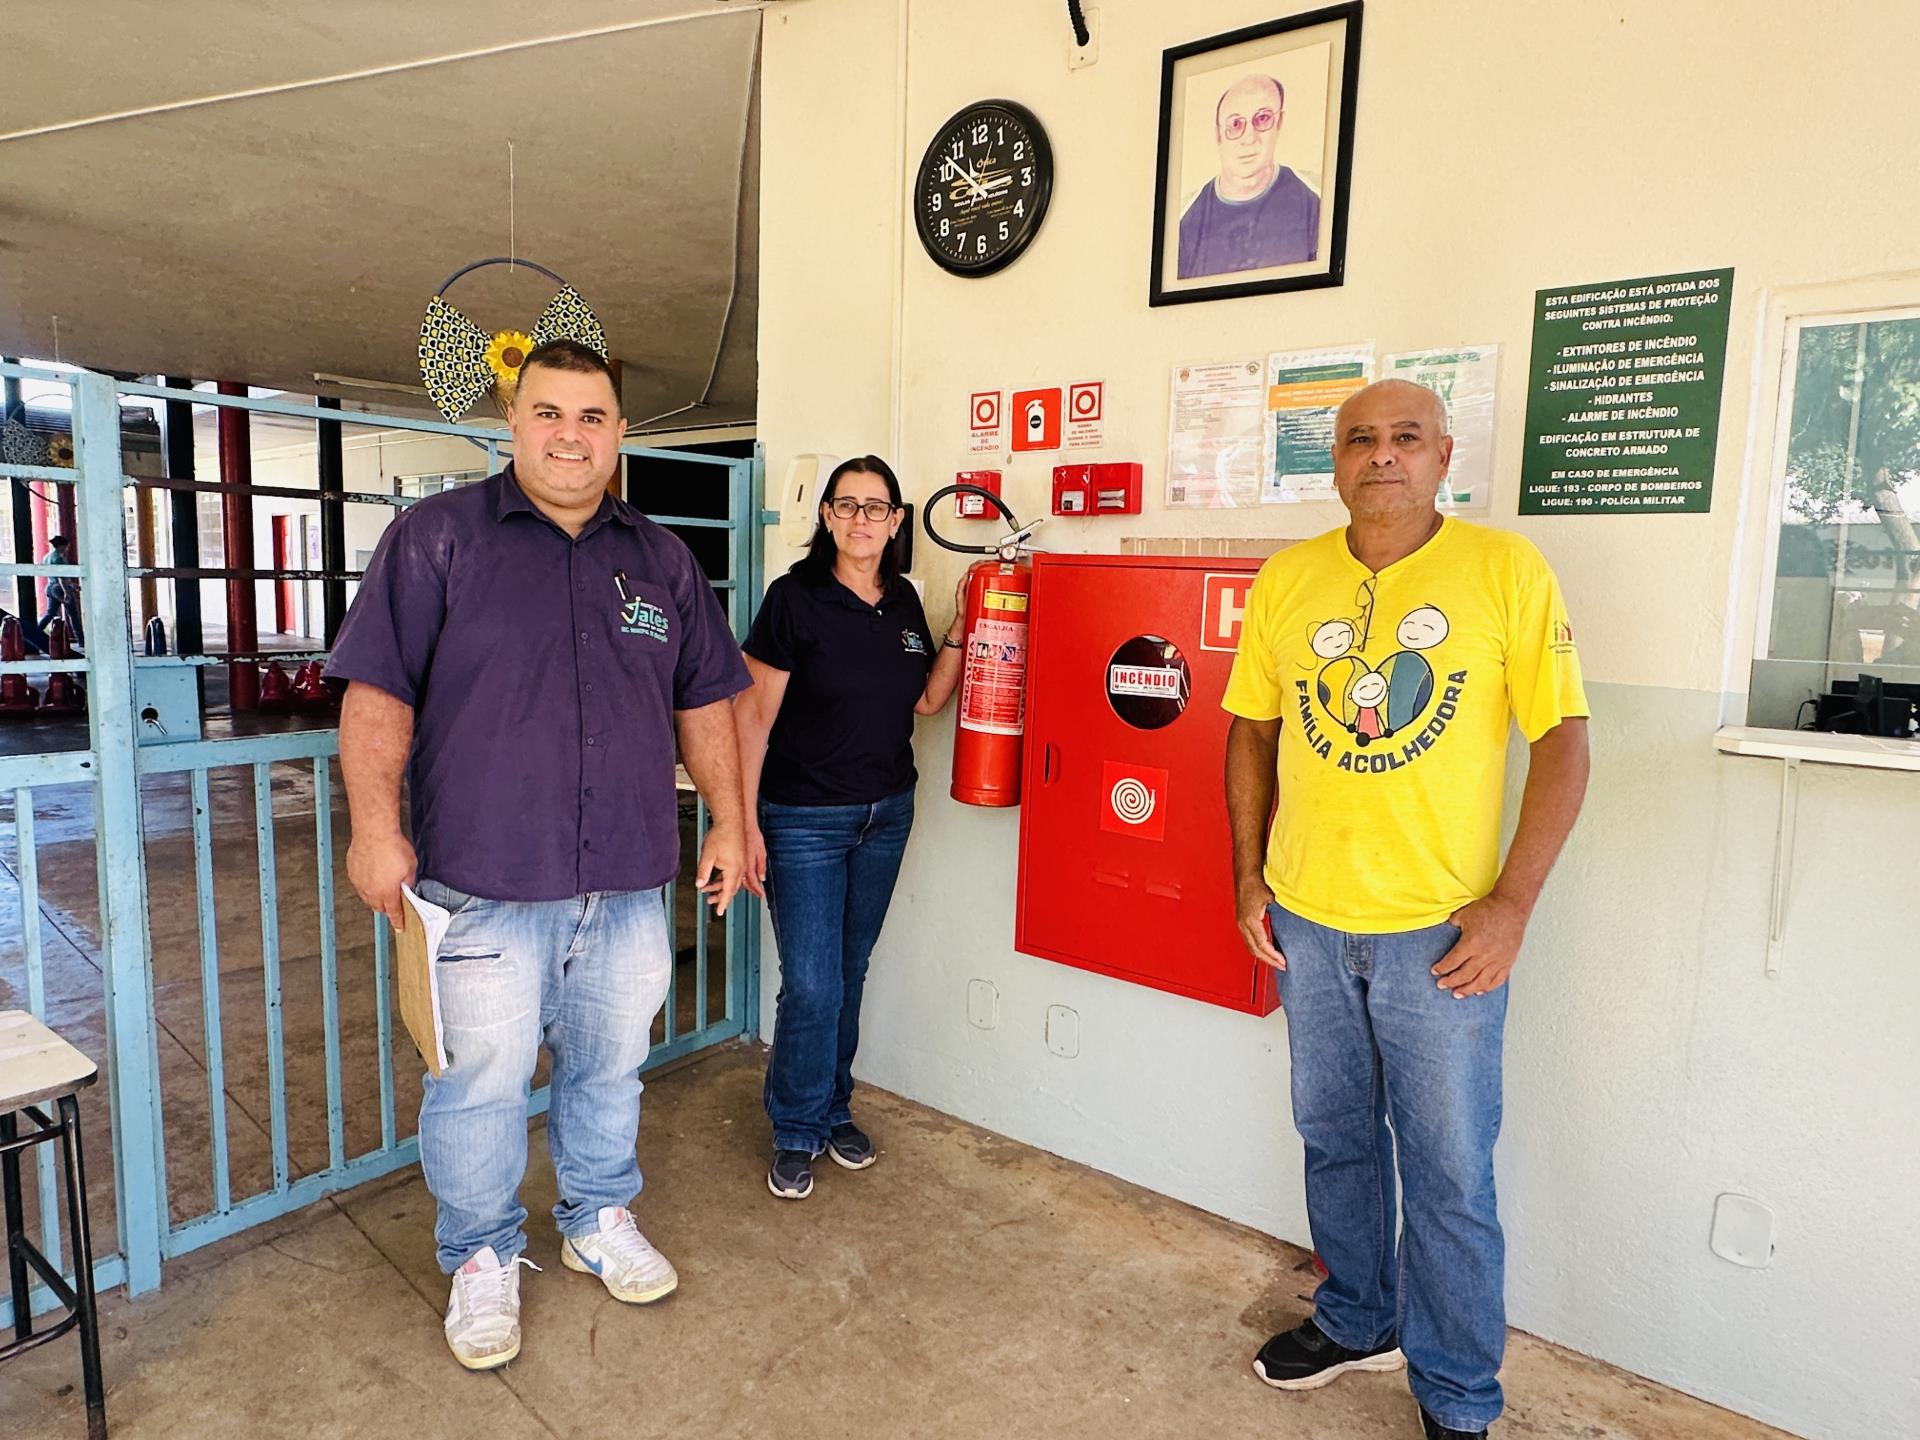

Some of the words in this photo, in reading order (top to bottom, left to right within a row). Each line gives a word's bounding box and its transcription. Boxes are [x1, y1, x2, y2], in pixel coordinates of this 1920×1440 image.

[972, 124, 988, 145] 12
[997, 126, 1004, 145] 1
[952, 140, 964, 160] 11
[1014, 141, 1023, 161] 2
[939, 163, 954, 182] 10
[1021, 166, 1031, 186] 3
[932, 193, 941, 211] 9
[1014, 199, 1024, 217] 4
[940, 218, 949, 236] 8
[999, 221, 1008, 240] 5
[957, 232, 966, 252] 7
[977, 235, 986, 254] 6
[1546, 296, 1568, 306] ESTA
[1571, 289, 1626, 303] EDIFICAÇÃO
[1629, 285, 1654, 297] ESTÁ
[1656, 282, 1696, 294] DOTADA
[1698, 278, 1719, 289] DOS
[1545, 307, 1596, 320] SEGUINTES
[1599, 302, 1646, 315] SISTEMAS
[1649, 300, 1662, 310] DE
[1664, 294, 1719, 308] PROTEÇÃO
[1582, 320, 1620, 331] CONTRA
[1623, 313, 1674, 327] INCÊNDIO:
[1563, 343, 1625, 357] EXTINTORES
[1628, 340, 1642, 350] DE
[1645, 335, 1697, 349] INCÊNDIO
[1553, 360, 1615, 375] ILUMINAÇÃO
[1618, 359, 1632, 369] DE
[1634, 353, 1704, 368] EMERGÊNCIA
[1550, 377, 1616, 392] SINALIZAÇÃO
[1618, 376, 1632, 386] DE
[1635, 370, 1704, 385] EMERGÊNCIA
[1594, 392, 1653, 405] HIDRANTES
[1568, 411, 1609, 423] ALARME
[1611, 410, 1625, 420] DE
[1628, 406, 1679, 419] INCÊNDIO
[971, 430, 999, 438] ALARME
[1539, 432, 1599, 445] EDIFICAÇÃO
[1601, 432, 1617, 441] EM
[1619, 429, 1682, 440] ESTRUTURA
[1685, 428, 1700, 437] DE
[1565, 447, 1620, 458] CONCRETO
[1622, 445, 1668, 456] ARMADO
[1551, 471, 1566, 479] EM
[1568, 470, 1594, 478] CASO
[1596, 470, 1610, 478] DE
[1612, 466, 1679, 477] EMERGÊNCIA
[1529, 485, 1560, 493] LIGUE:
[1563, 485, 1580, 493] 193
[1587, 484, 1622, 492] CORPO
[1624, 483, 1638, 491] DE
[1640, 481, 1702, 490] BOMBEIROS
[1541, 498, 1573, 506] LIGUE:
[1575, 498, 1593, 506] 190
[1601, 496, 1641, 505] POLÍCIA
[1643, 496, 1685, 505] MILITAR
[621, 596, 669, 630] Jales
[1218, 587, 1251, 638] H
[1115, 671, 1175, 688] INCÊNDIO
[1295, 679, 1333, 760] FAMÍLIA
[1337, 669, 1468, 774] ACOLHEDORA
